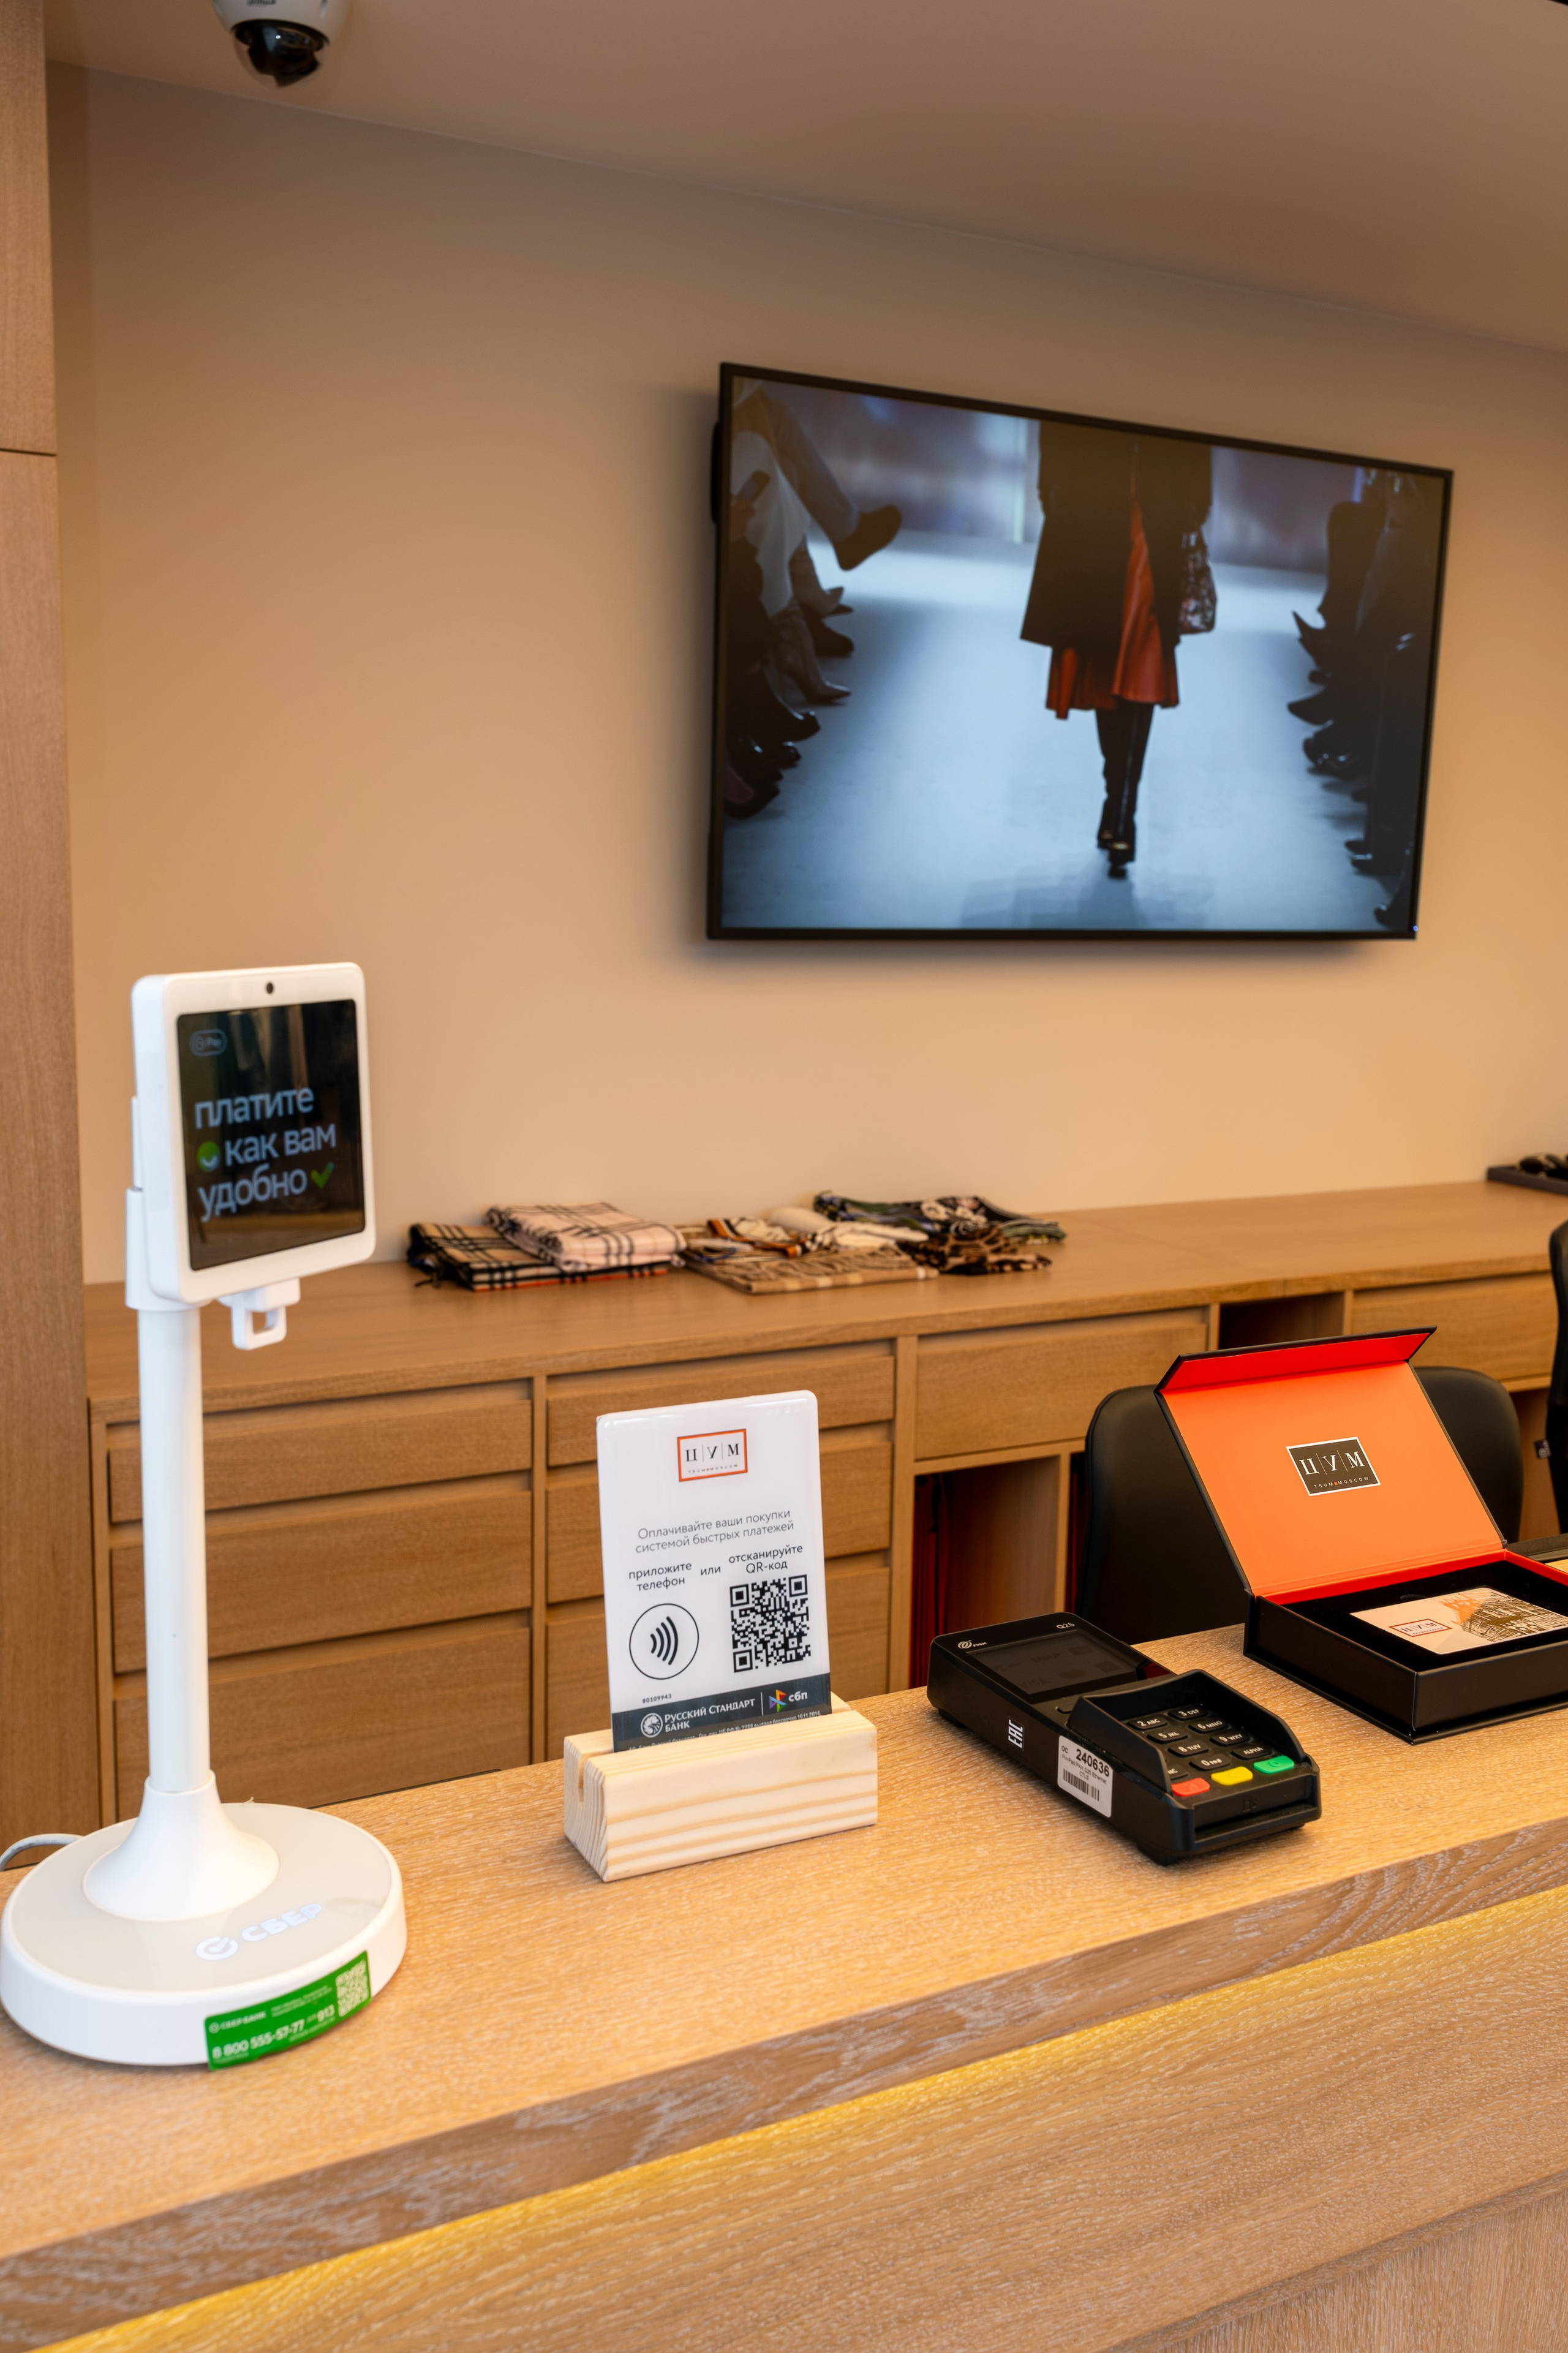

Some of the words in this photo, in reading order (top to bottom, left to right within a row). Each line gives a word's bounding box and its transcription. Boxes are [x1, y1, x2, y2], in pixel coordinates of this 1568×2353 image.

[194, 1086, 314, 1130] платите
[224, 1135, 279, 1167] как
[284, 1124, 336, 1157] вам
[198, 1164, 307, 1223] удобно
[1338, 1476, 1369, 1485] MOSCOW
[638, 1520, 712, 1539] Оплачивайте
[716, 1517, 743, 1529] ваши
[746, 1510, 791, 1525] покупки
[636, 1535, 690, 1554] системой
[693, 1530, 740, 1546] быстрых
[743, 1520, 794, 1538] платежей
[729, 1544, 803, 1563] отсканируйте
[629, 1563, 692, 1581] приложите
[700, 1566, 721, 1576] или
[746, 1561, 788, 1574] QR-код
[637, 1576, 685, 1592] телефон
[788, 1691, 808, 1702] сбп
[665, 1706, 707, 1723] РУССКИЙ
[709, 1698, 755, 1715] СТАНДАРТ
[665, 1721, 690, 1732] БАНК
[1243, 1746, 1264, 1755] ALPHA
[1076, 1748, 1110, 1777] 240636
[241, 1903, 322, 1942] СБЕР
[212, 2045, 222, 2059] 8
[223, 2039, 249, 2057] 800
[250, 2019, 305, 2050] 555-57-77
